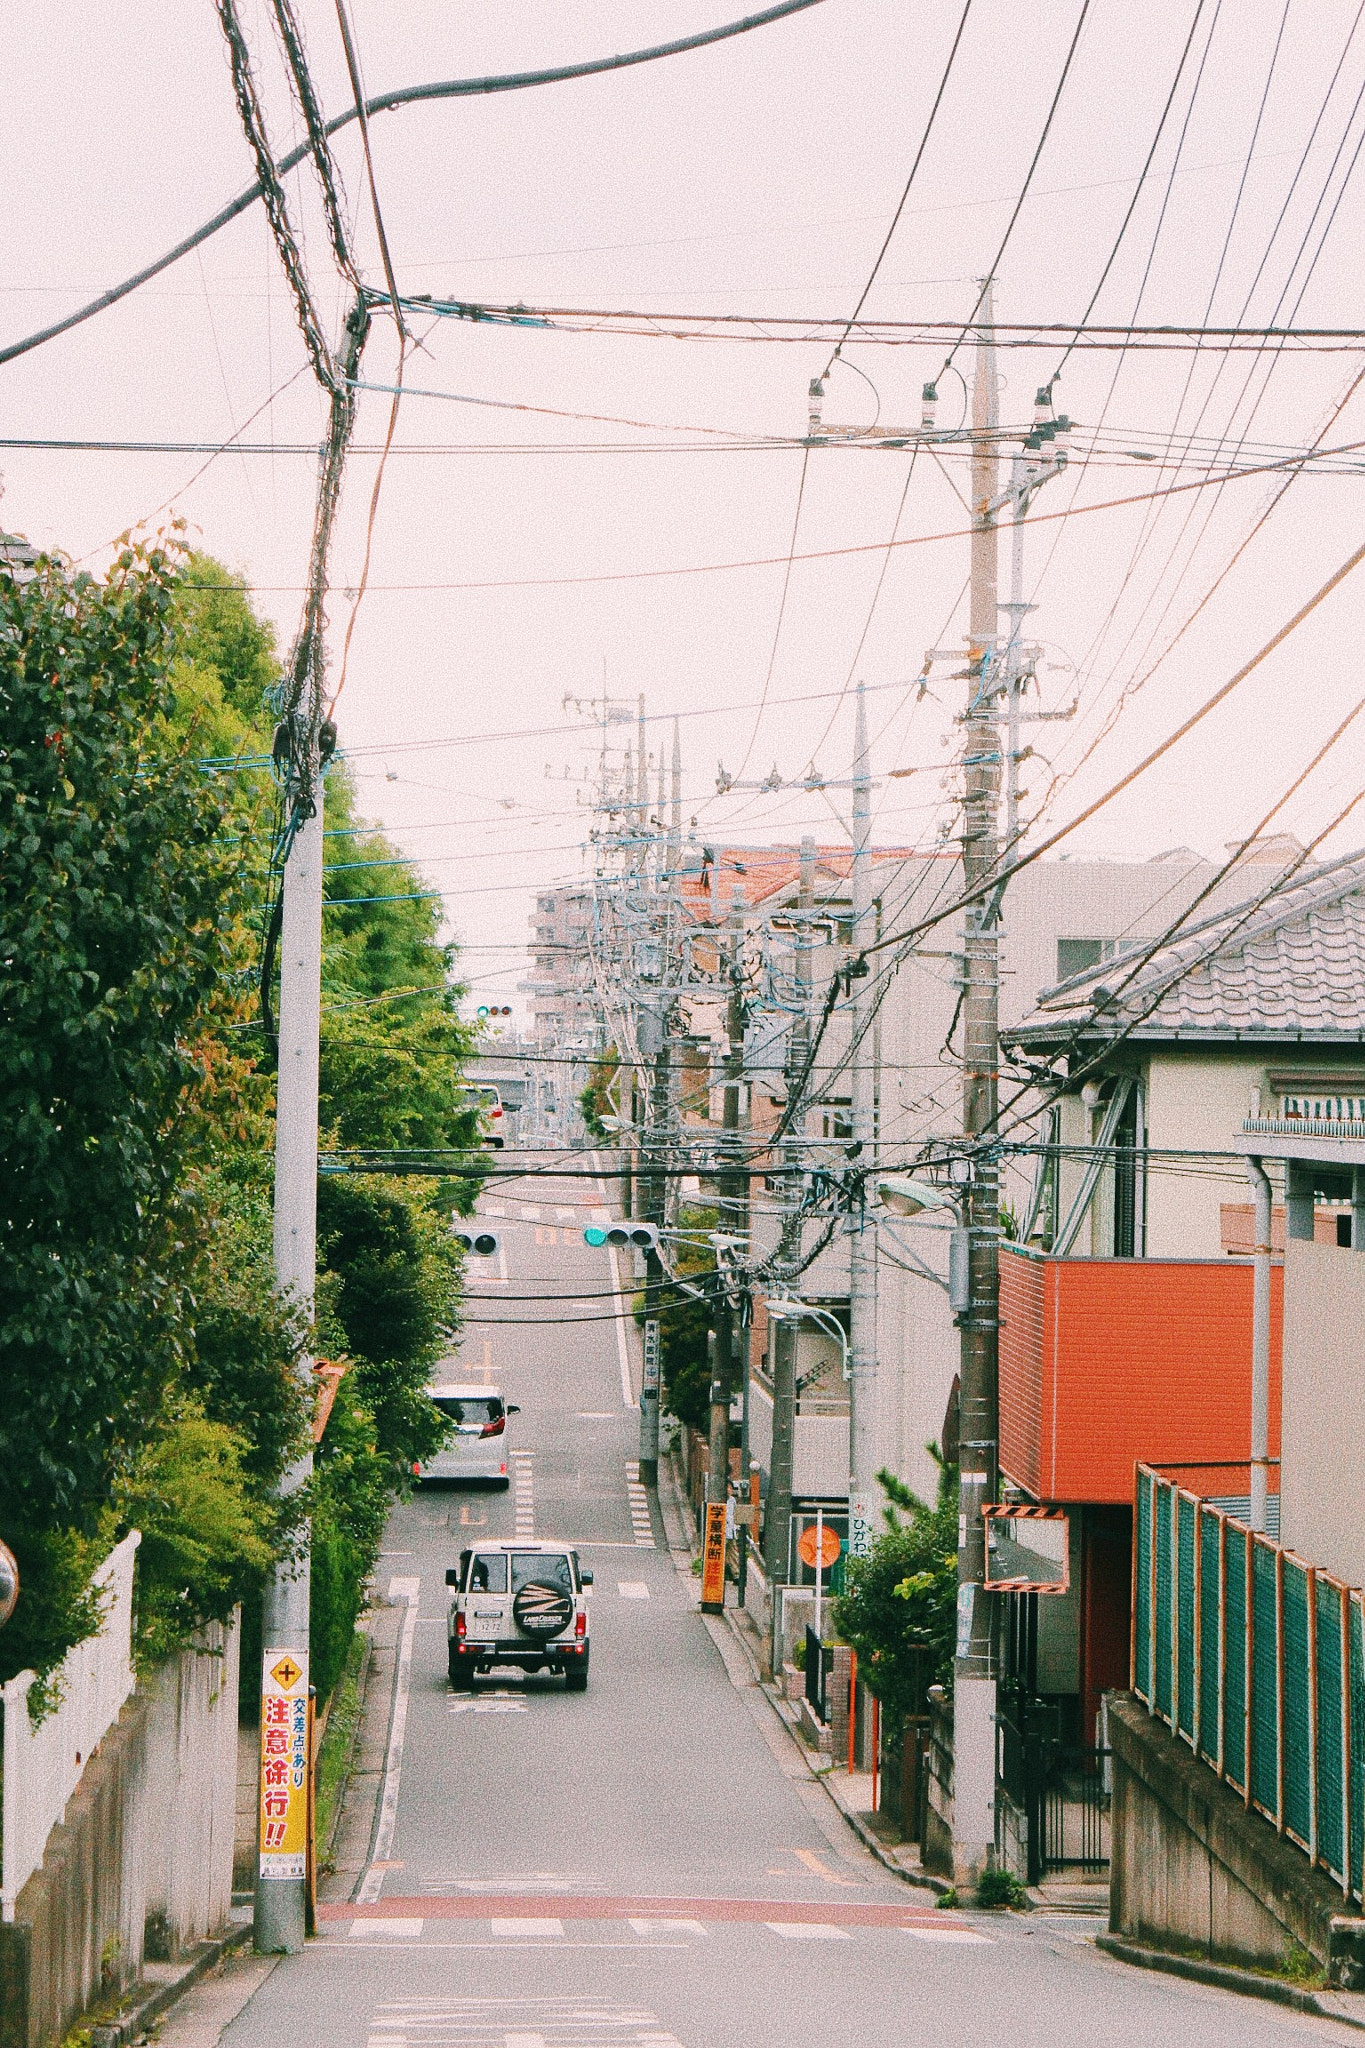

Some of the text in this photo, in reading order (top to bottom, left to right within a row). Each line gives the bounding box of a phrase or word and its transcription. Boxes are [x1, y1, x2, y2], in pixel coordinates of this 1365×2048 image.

[853, 1519, 867, 1557] ひがわ
[292, 1698, 307, 1788] 交差点あり
